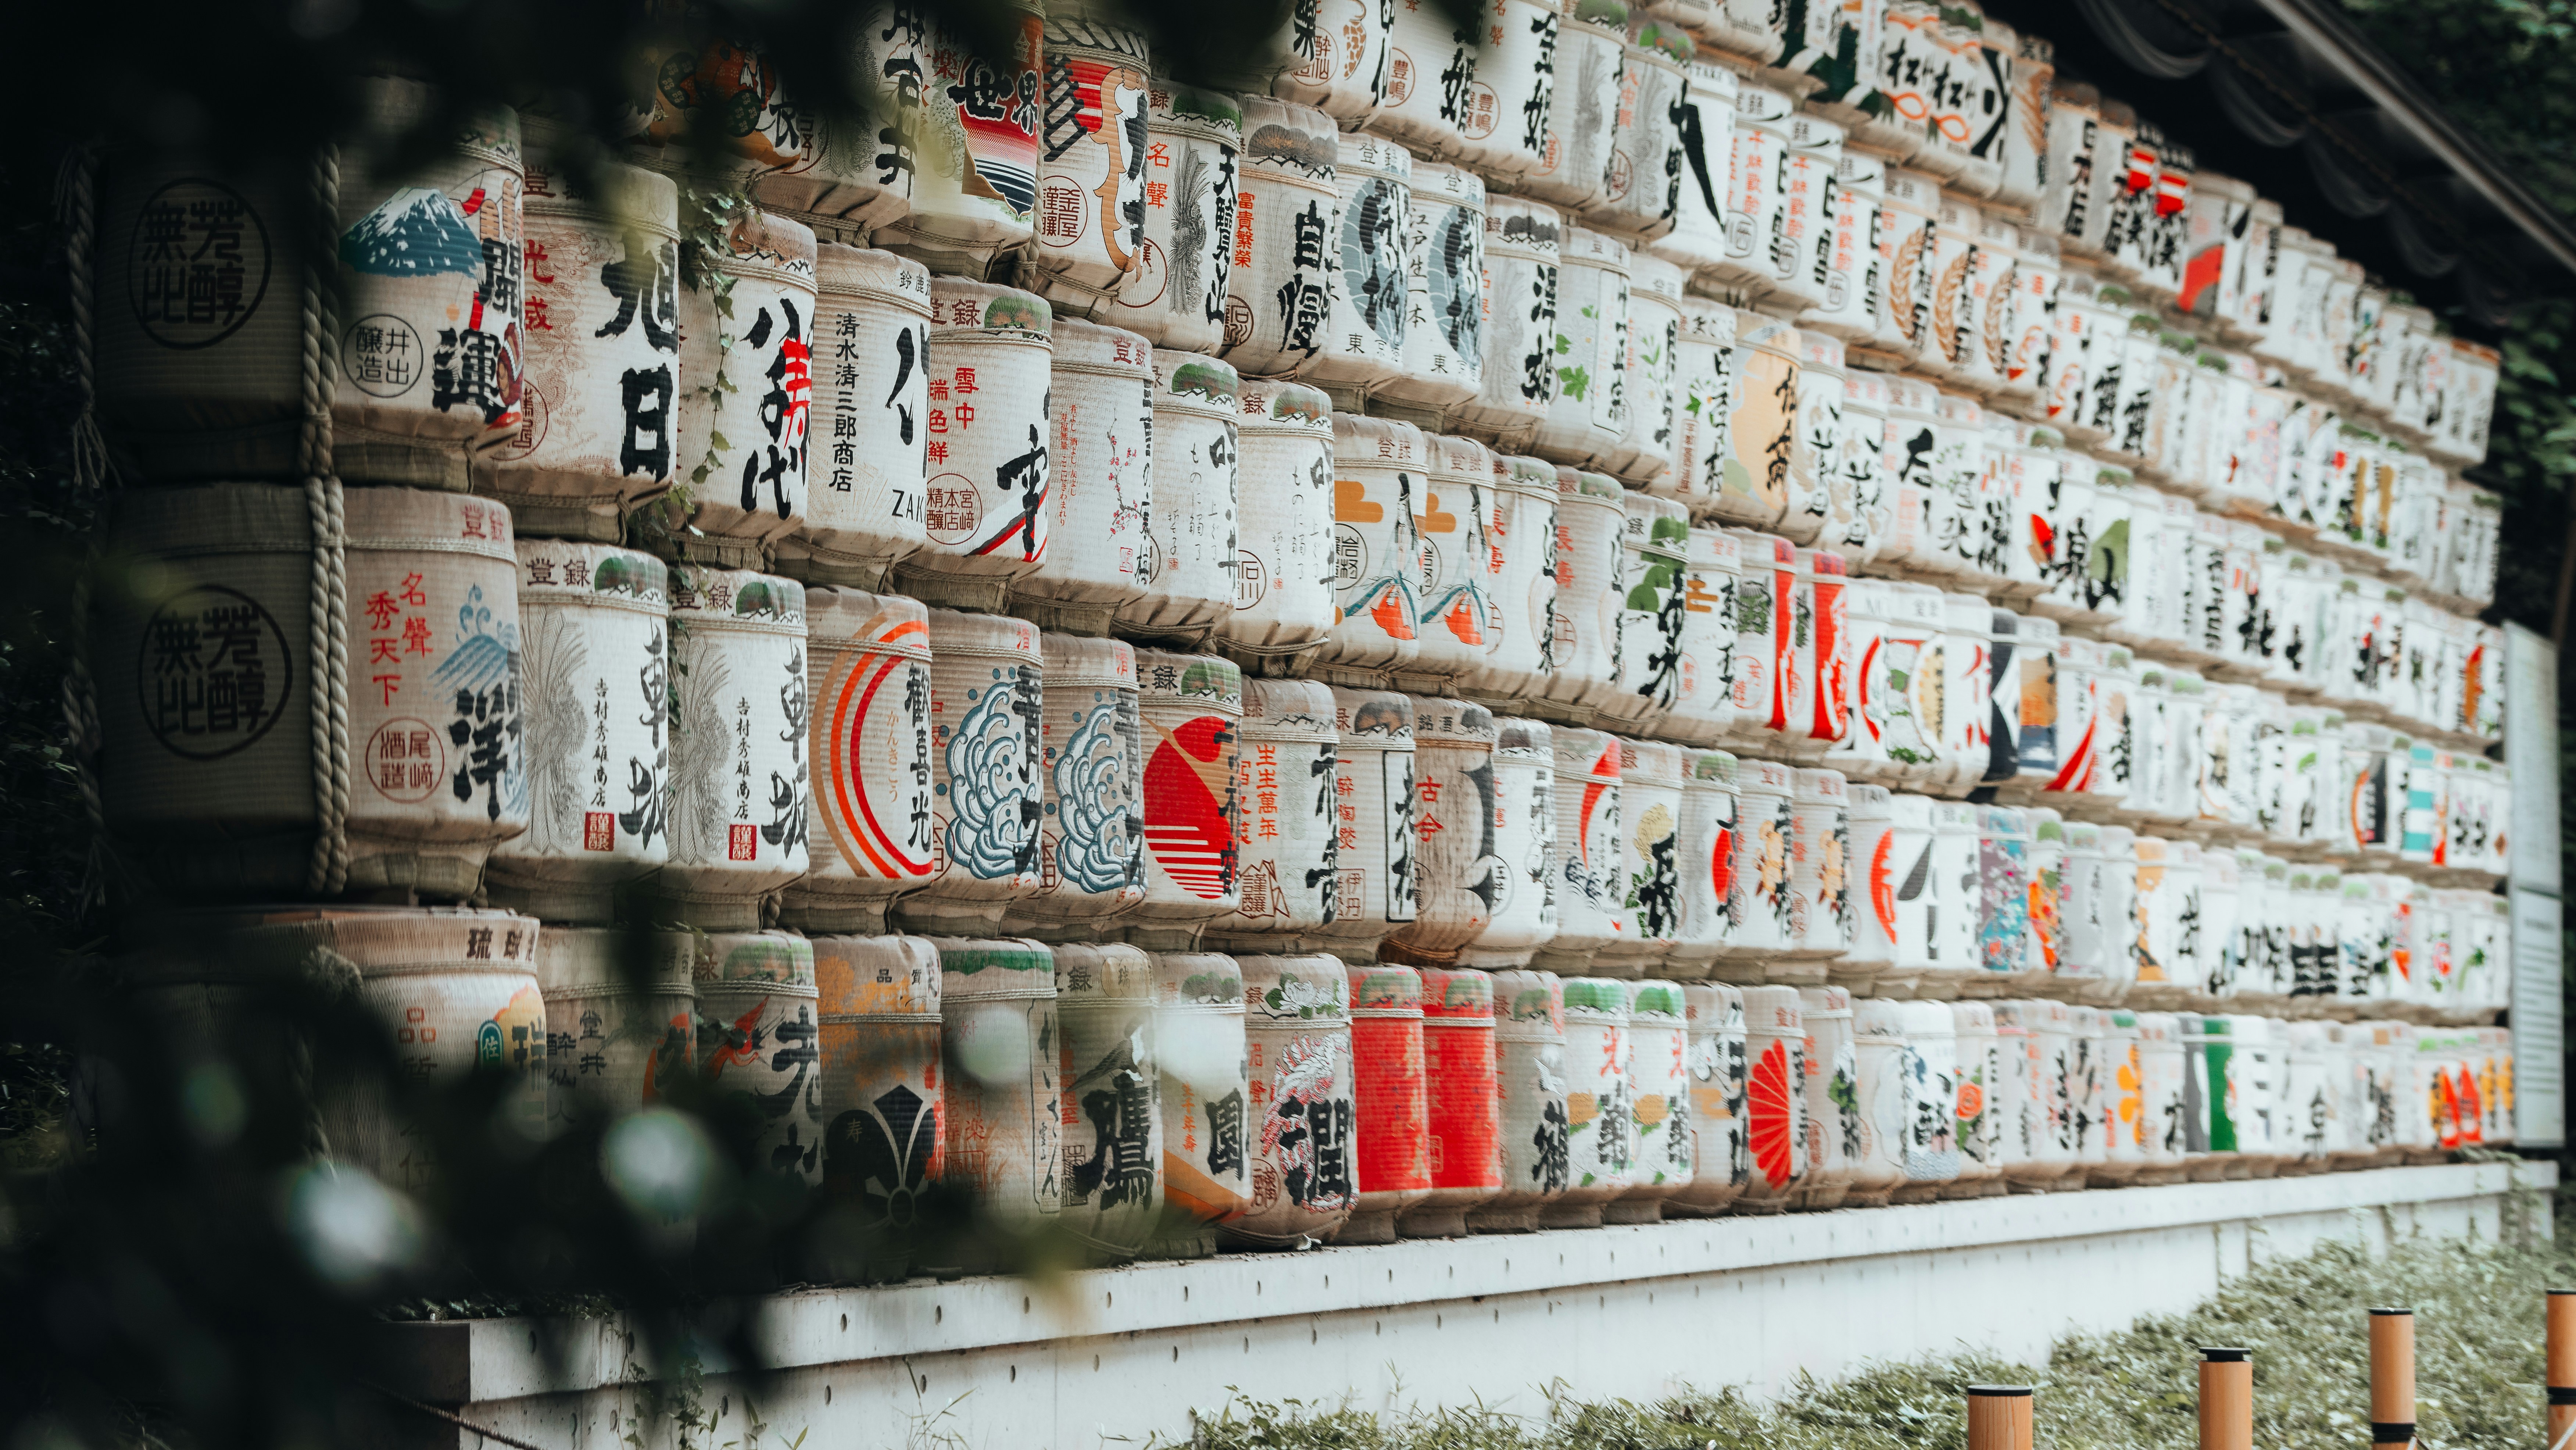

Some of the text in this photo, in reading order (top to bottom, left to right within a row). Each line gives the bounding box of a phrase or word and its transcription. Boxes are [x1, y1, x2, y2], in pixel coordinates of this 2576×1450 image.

[1146, 142, 1170, 210] 名聲
[386, 328, 409, 385] 井出
[831, 312, 861, 493] 清水清三郎商店
[954, 367, 980, 430] 雪中
[526, 558, 591, 588] 登録
[364, 590, 402, 707] 秀天下
[398, 571, 434, 659] 名聲
[1256, 743, 1279, 843] 生生萬年
